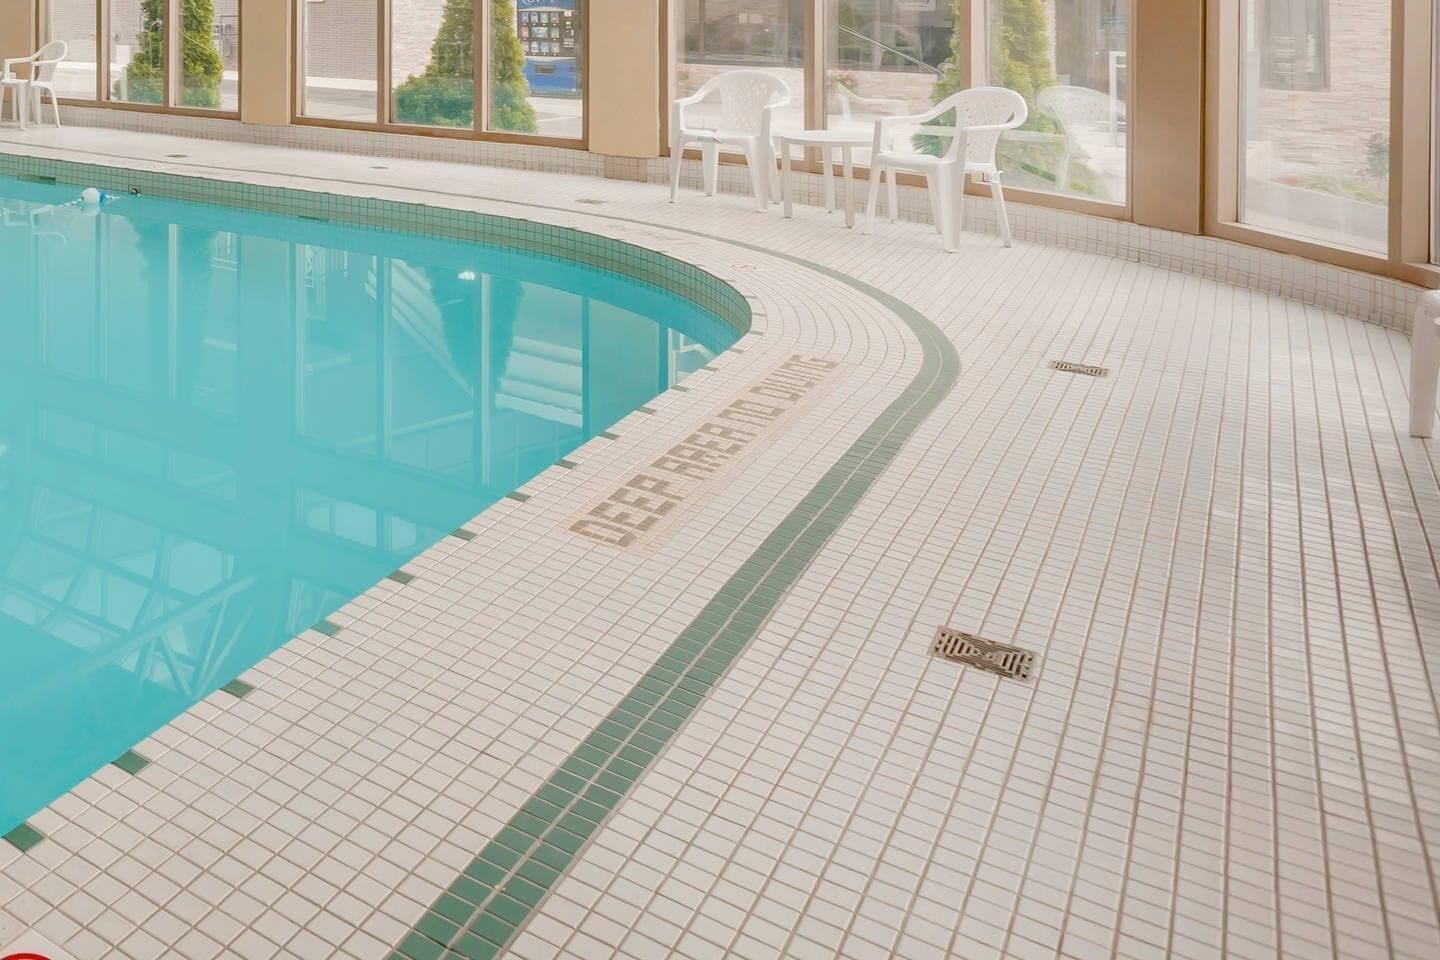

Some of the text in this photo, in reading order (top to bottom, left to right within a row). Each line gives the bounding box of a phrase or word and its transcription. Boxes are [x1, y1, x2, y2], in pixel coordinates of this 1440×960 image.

[568, 353, 840, 548] DEEP AREA NO DIVING
